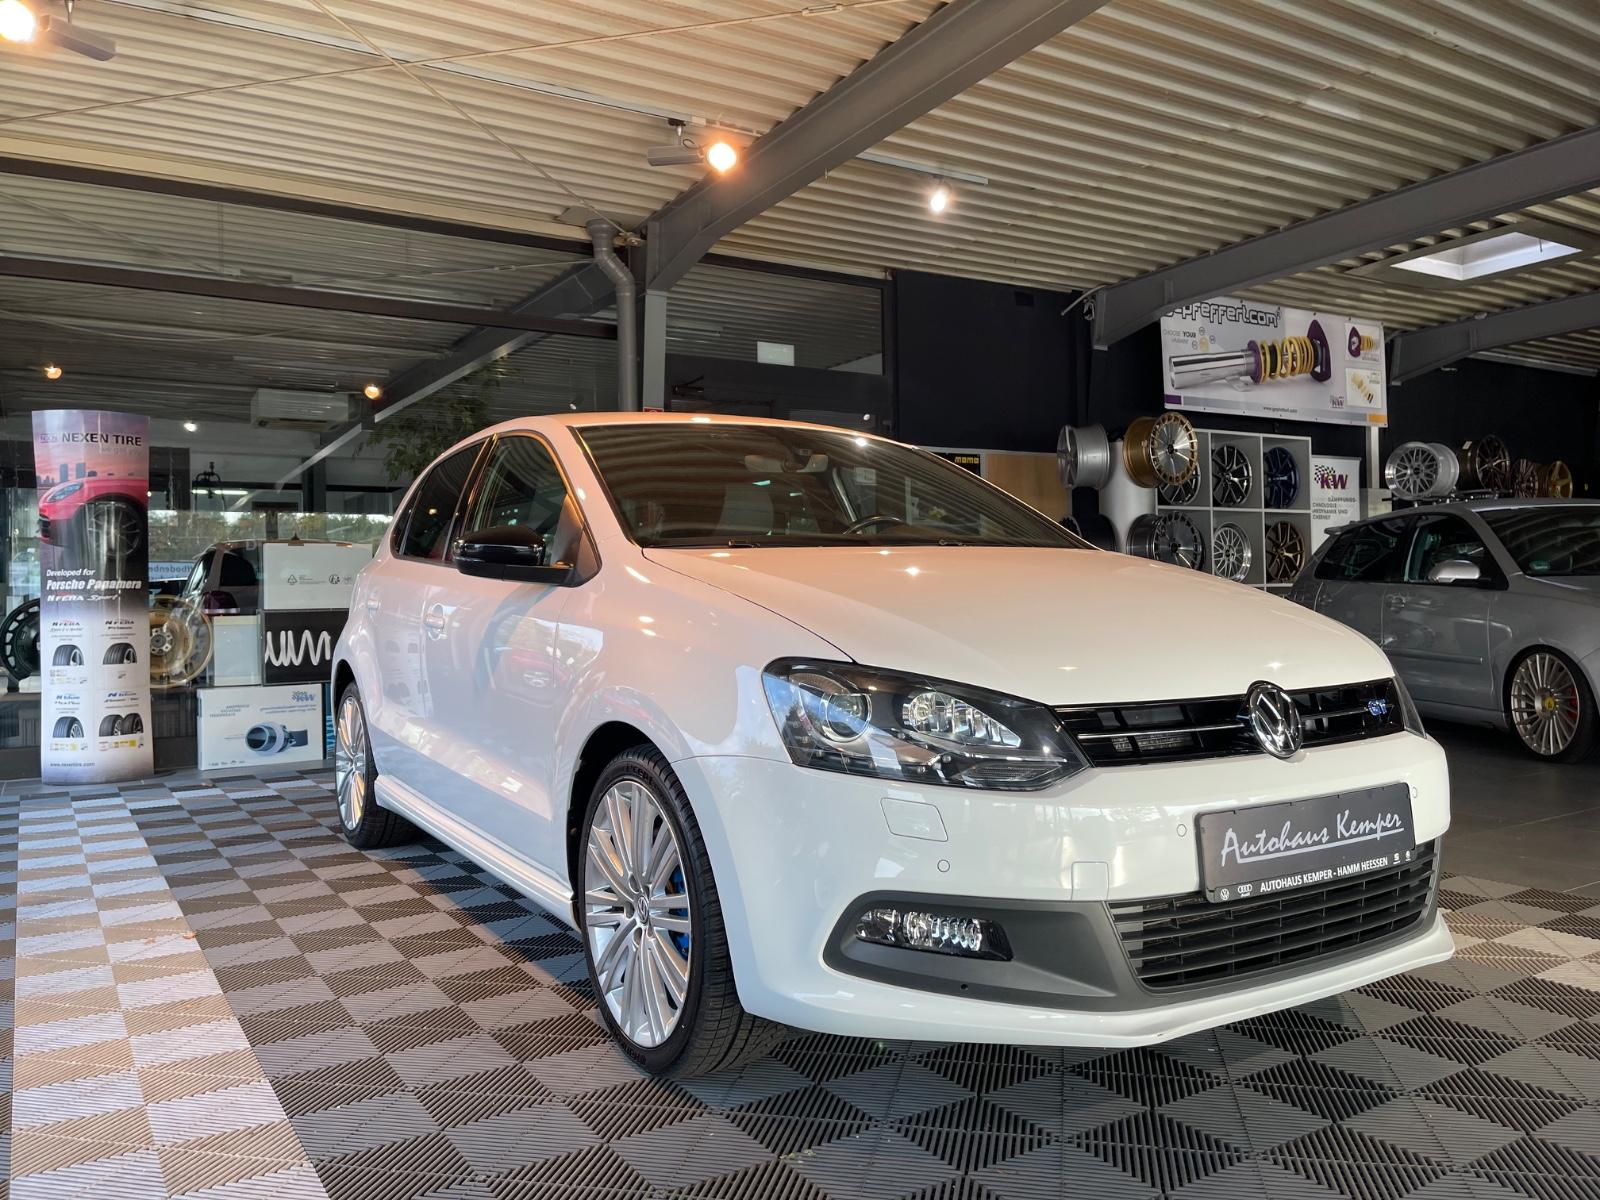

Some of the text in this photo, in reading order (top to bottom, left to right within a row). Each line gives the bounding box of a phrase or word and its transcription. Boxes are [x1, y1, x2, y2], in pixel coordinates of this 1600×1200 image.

[61, 432, 109, 443] NEXEN
[113, 434, 142, 446] TIRE
[954, 456, 979, 464] momo
[1320, 472, 1348, 490] KW
[46, 568, 96, 577] Developed for
[46, 579, 85, 590] Porsche
[1220, 809, 1402, 867] Autohaus Kemper
[1260, 876, 1303, 893] AUTOHAUS
[1303, 869, 1333, 885] KEMPER
[1337, 863, 1361, 878] HAMM
[1361, 856, 1389, 872] HEESSEN
